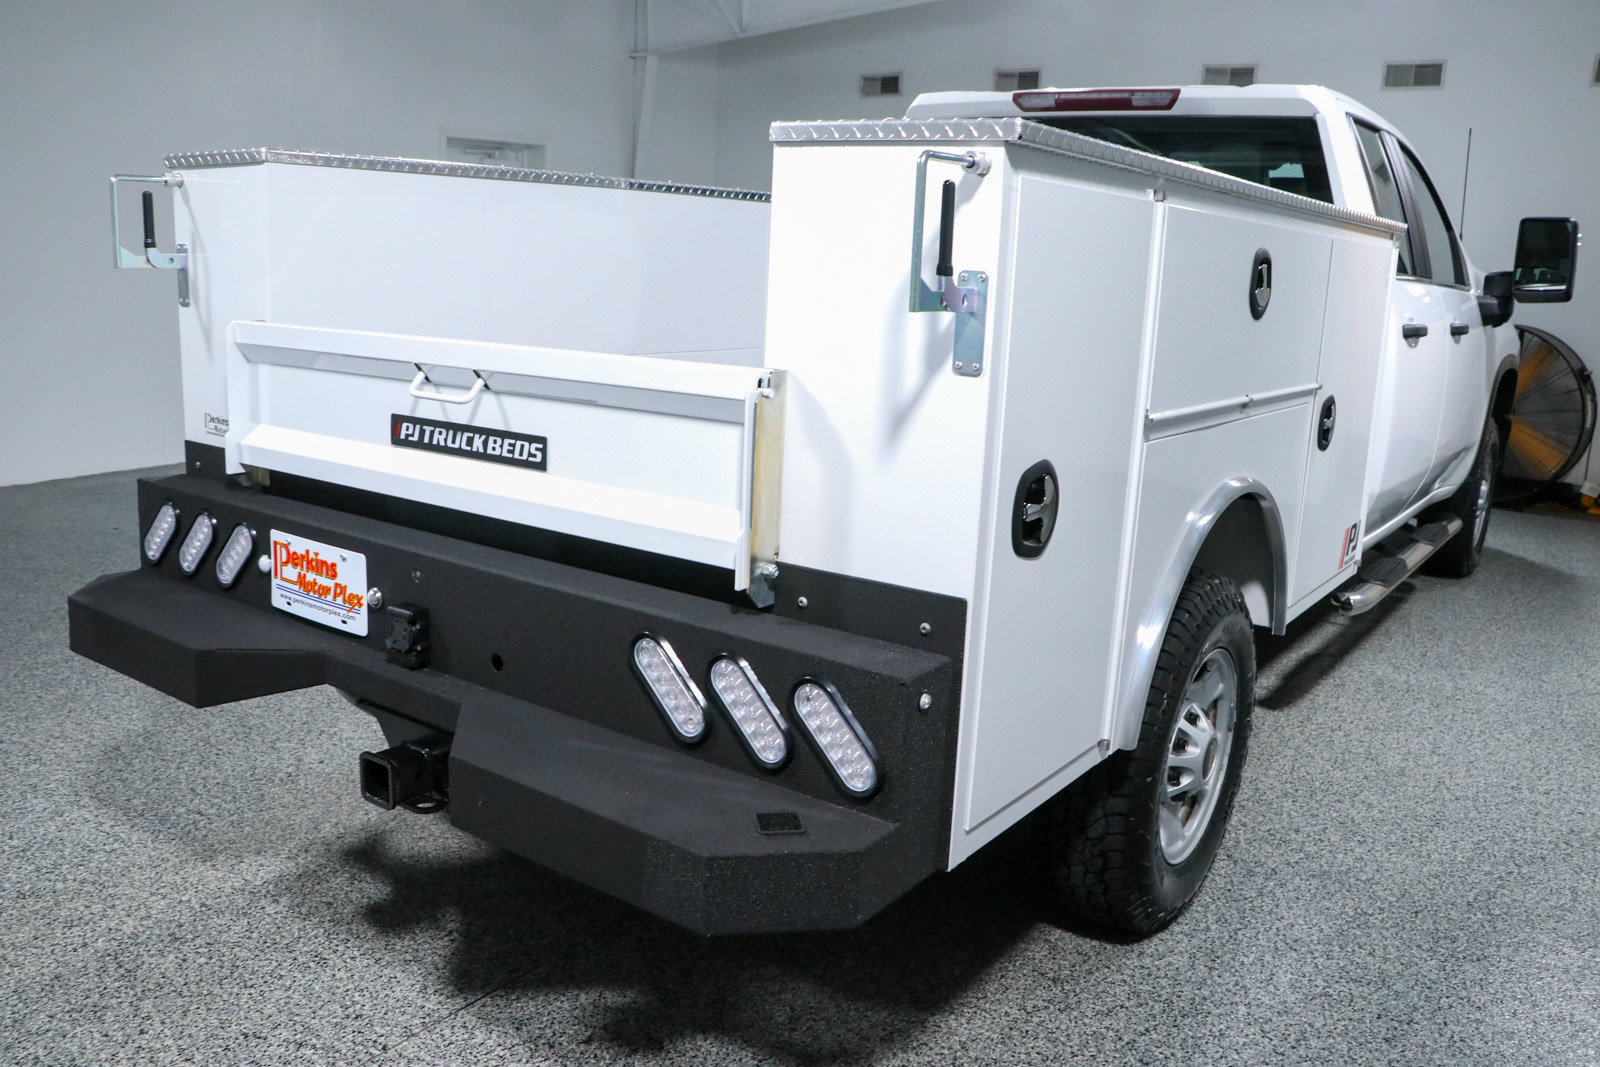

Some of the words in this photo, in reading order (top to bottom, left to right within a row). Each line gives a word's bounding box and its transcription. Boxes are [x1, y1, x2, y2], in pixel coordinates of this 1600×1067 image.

[400, 422, 421, 442] PJ
[422, 425, 487, 453] TRUCK
[486, 436, 544, 463] BEDS
[273, 540, 338, 580] Perkins
[280, 593, 357, 621] www.perkinsmotorplex.com
[297, 571, 332, 598] Motor
[333, 581, 364, 613] Plex
